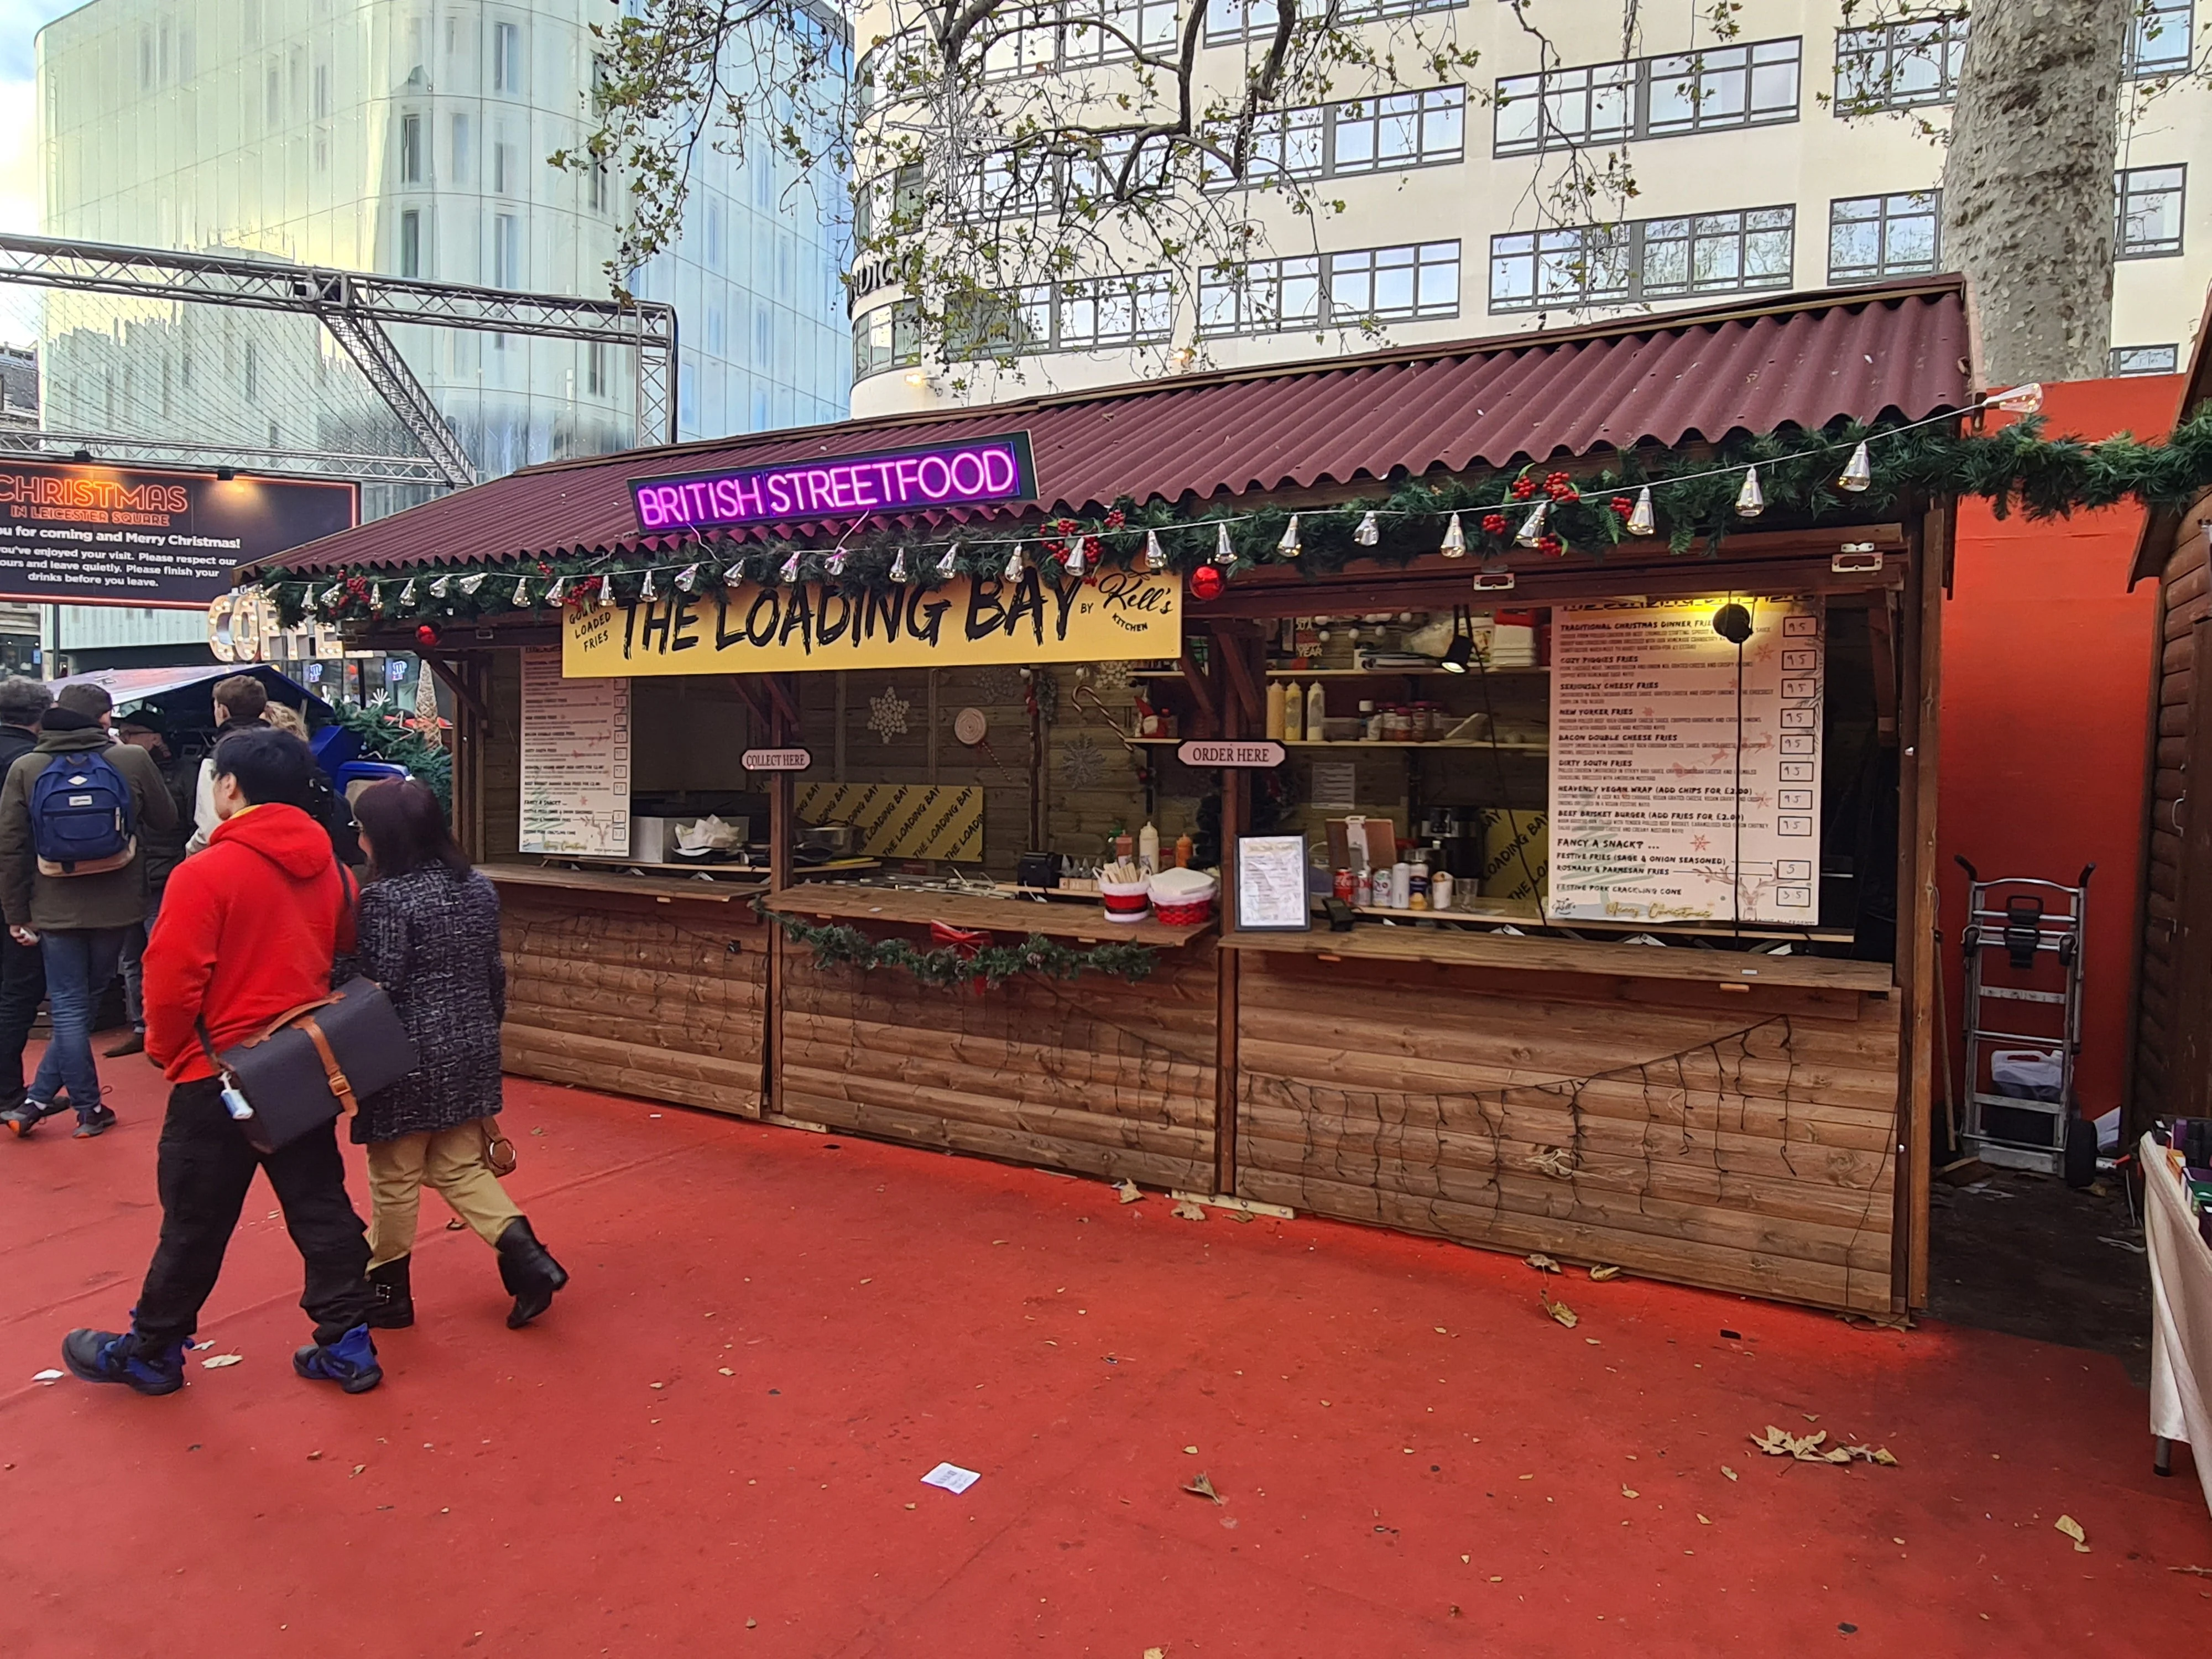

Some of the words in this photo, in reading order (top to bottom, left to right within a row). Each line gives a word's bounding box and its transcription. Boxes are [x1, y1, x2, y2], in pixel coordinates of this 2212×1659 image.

[0, 474, 187, 513] CHRISTMAS
[638, 477, 764, 526] BRITISH
[11, 504, 27, 518] IN
[31, 507, 109, 523] LEICESTER
[112, 512, 170, 526] SQUARE
[15, 525, 37, 537] for
[40, 529, 93, 542] coming
[96, 531, 123, 542] and
[126, 533, 166, 546] Merry
[168, 535, 241, 549] Christmas!
[34, 547, 78, 558] enjoyed
[81, 551, 107, 560] your
[109, 551, 134, 561] visit.
[139, 552, 174, 562] Please
[176, 555, 216, 565] respect
[218, 557, 237, 566] our
[27, 560, 48, 568] and
[50, 560, 79, 570] leave
[82, 563, 122, 573] quietly.
[126, 564, 161, 574] Please
[164, 566, 192, 576] finish
[195, 569, 220, 577] your
[28, 572, 62, 581] drinks
[65, 574, 102, 584] before
[105, 577, 124, 586] you
[127, 577, 159, 587] leave.
[1081, 602, 1094, 614] BY
[1098, 573, 1173, 614] Kell's
[617, 594, 701, 660] THE
[716, 580, 952, 656] LOADING
[964, 566, 1083, 646] BAY
[1112, 613, 1148, 632] KITCHEN
[575, 612, 611, 639] LOADED
[1615, 621, 1657, 629] CHRISTMAS
[1695, 619, 1713, 627] FRIE
[583, 630, 608, 653] FRIES
[746, 754, 781, 766] COLLECT
[783, 754, 805, 766] HERE
[1193, 748, 1234, 761] ORDER
[1237, 748, 1270, 762] HERE
[806, 782, 820, 801] BAY
[834, 783, 849, 802] BAY
[863, 784, 879, 803] BAY
[866, 801, 896, 841] LOADING
[893, 785, 909, 804] BAY
[882, 840, 898, 858] THE
[895, 803, 927, 843] LOADING
[924, 785, 941, 805] BAY
[913, 841, 929, 859] THE
[927, 804, 958, 844] LOADING
[956, 786, 973, 806] BAY
[944, 842, 961, 861] THE
[1557, 838, 1589, 847] FANCY
[1592, 839, 1599, 848] A
[1603, 840, 1644, 849] SNACK?
[1483, 833, 1530, 881] LOADING
[1679, 857, 1726, 865] SEASONED)
[1647, 867, 1670, 875] FRIES
[1507, 880, 1531, 900] THE
[1556, 883, 1586, 891] FESTIVE
[1613, 886, 1657, 895] CRACKLING
[1606, 902, 1639, 918] Merry
